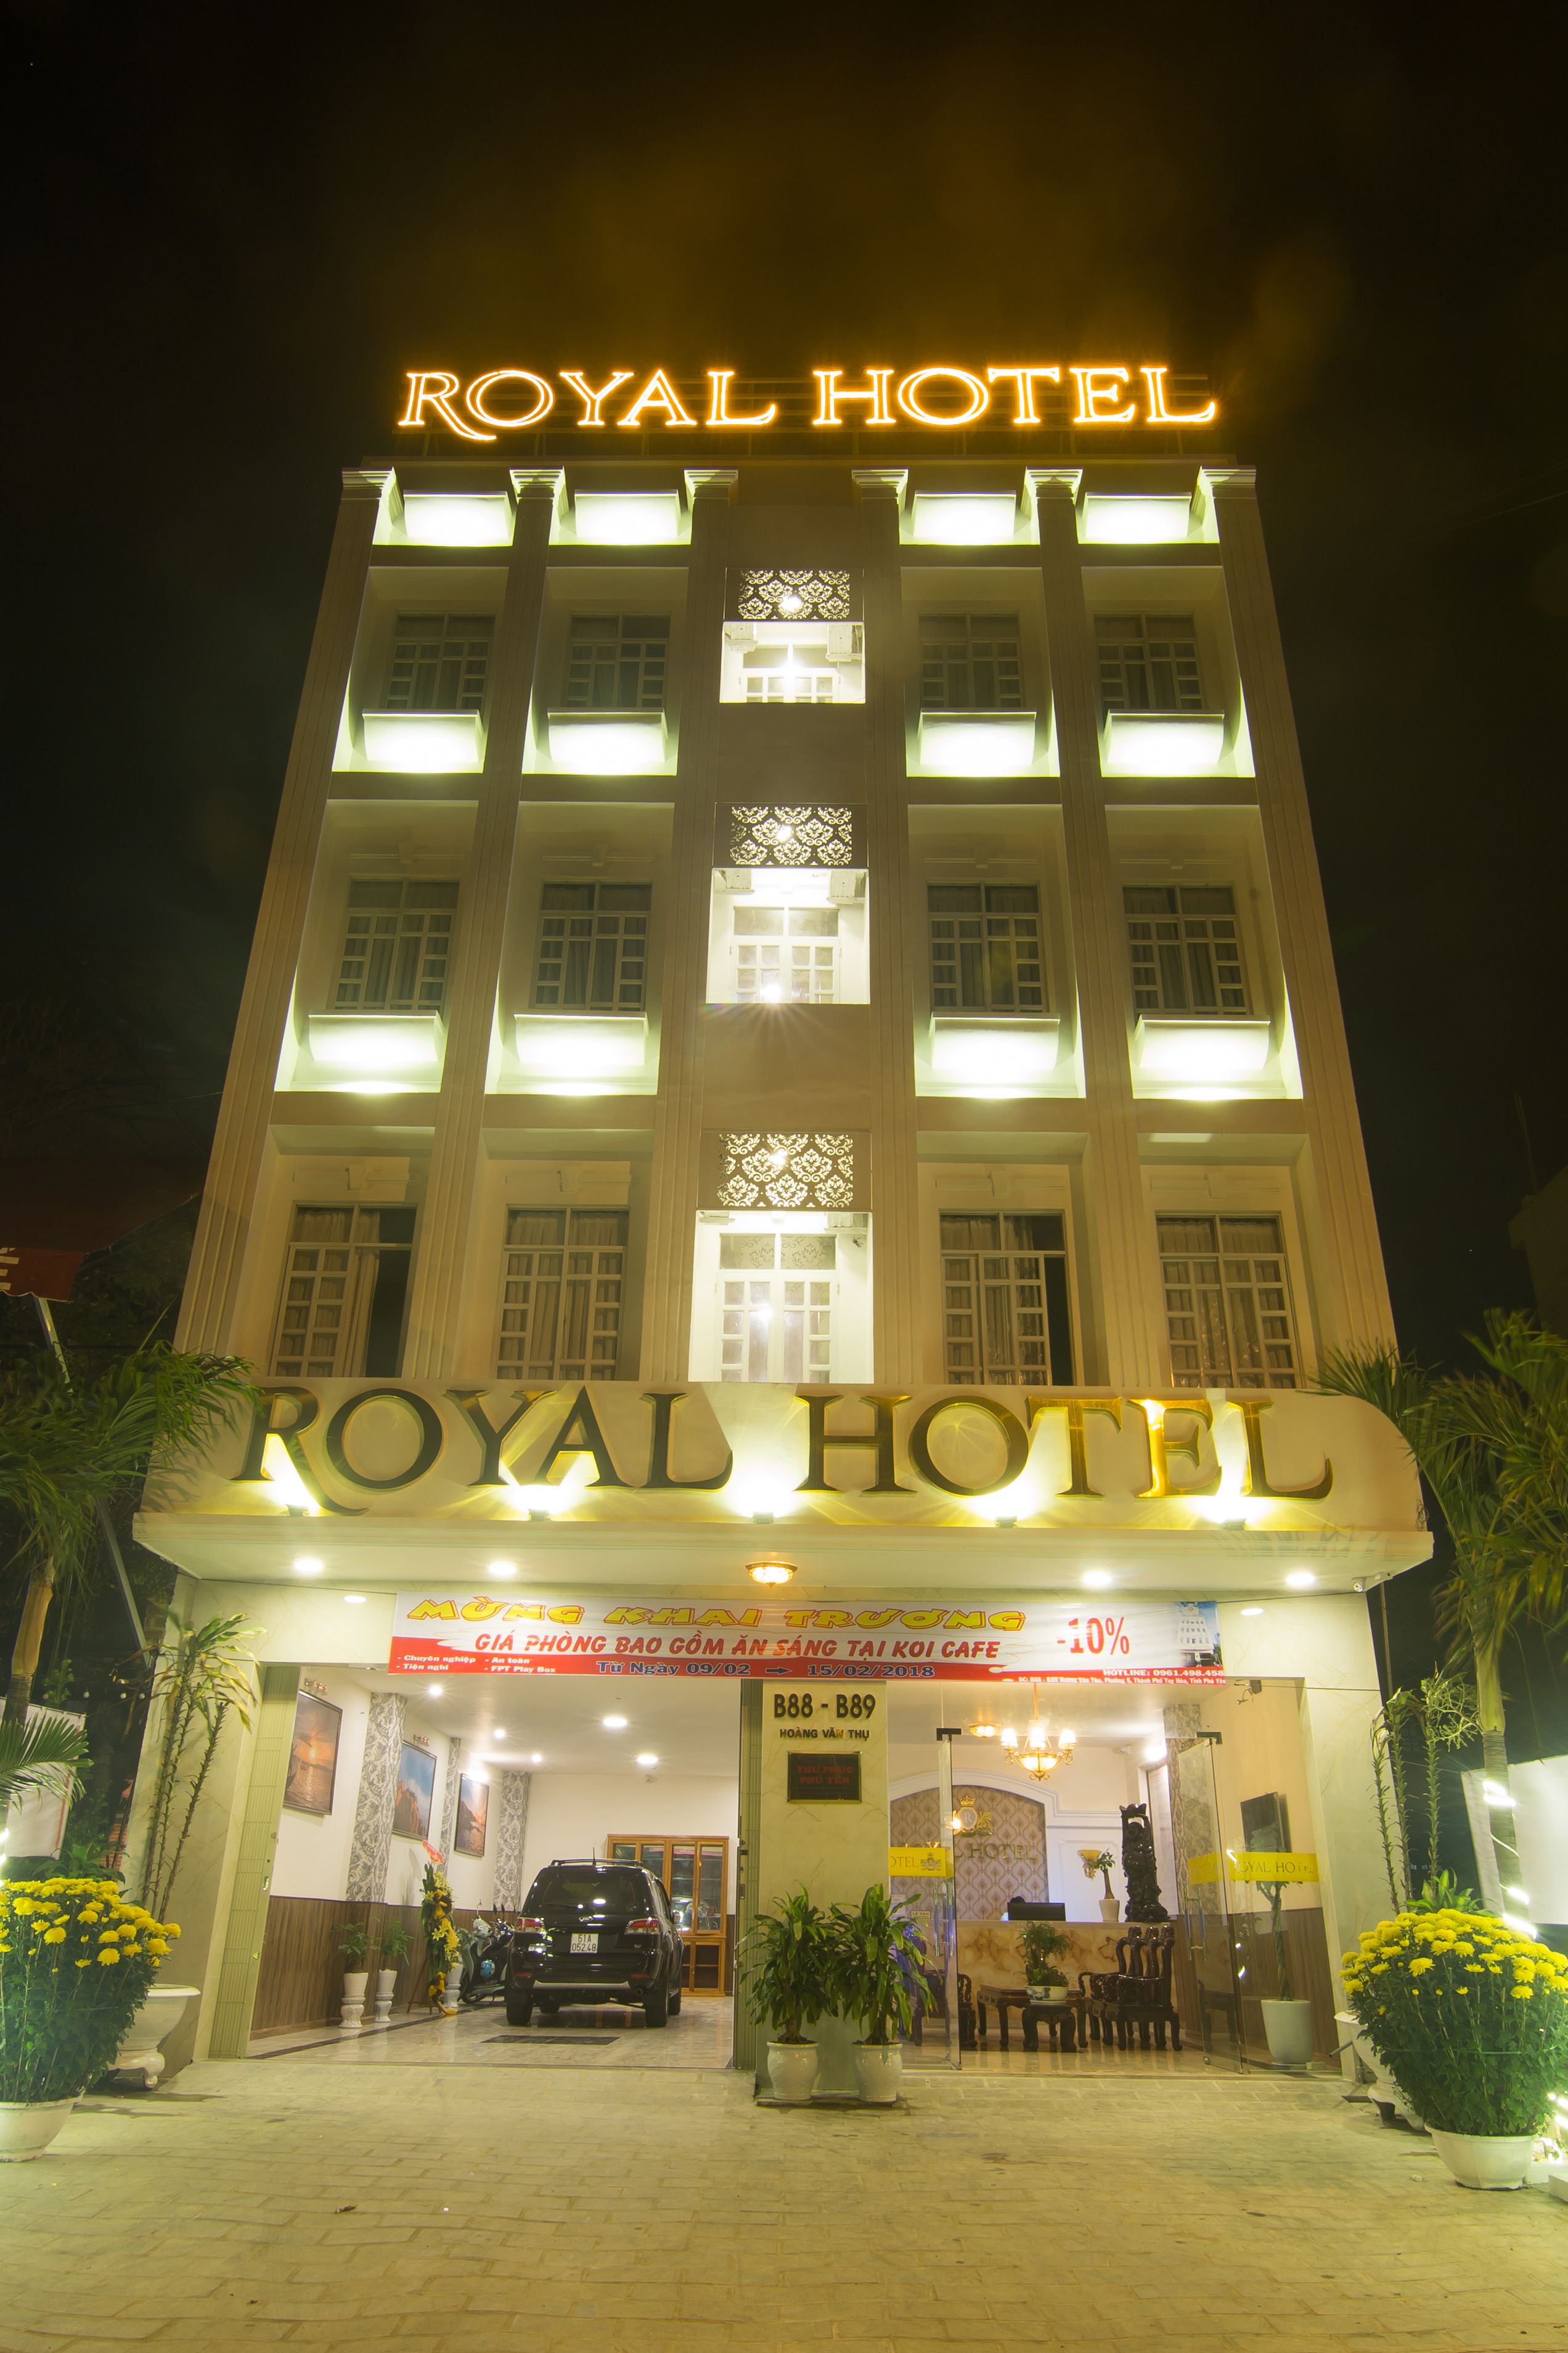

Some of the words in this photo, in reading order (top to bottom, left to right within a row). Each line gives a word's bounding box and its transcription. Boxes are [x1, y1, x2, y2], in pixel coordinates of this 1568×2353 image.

[398, 369, 776, 440] ROYAL
[812, 367, 1215, 425] HOTEL
[232, 1385, 733, 1514] ROYAL
[793, 1394, 1333, 1499] HOTEL
[407, 1596, 585, 1624] MỪNG
[603, 1607, 762, 1627] KHAI
[783, 1609, 1026, 1631] TRƯƠNG
[1056, 1617, 1130, 1655] -10%
[475, 1629, 515, 1651] GIÁ
[524, 1631, 607, 1653] PHÒNG
[615, 1636, 663, 1654] BAO
[669, 1630, 725, 1655] GỒM
[731, 1634, 769, 1656] ĂN
[773, 1635, 837, 1656] SÁNG
[847, 1640, 880, 1661] TẠI
[891, 1640, 935, 1658] KOI
[941, 1641, 1001, 1658] CAFE
[404, 1655, 439, 1663] Chuyên
[443, 1655, 476, 1663] nghiệp
[597, 1661, 625, 1673] Từ
[629, 1661, 680, 1676] Ngày
[685, 1663, 750, 1675] 09/02
[807, 1664, 934, 1677] 15/02/2018
[774, 1693, 814, 1718] B88
[836, 1693, 876, 1718] B89
[780, 1727, 819, 1738] HOÀNG
[822, 1727, 844, 1738] VĂN
[848, 1729, 870, 1741] THỤ
[966, 1843, 1037, 1859] HOTEL
[890, 1856, 919, 1868] OTEL
[1237, 1861, 1271, 1873] OYAL
[1276, 1862, 1314, 1873] HOT
[578, 1934, 592, 1943] 51A
[571, 1943, 597, 1952] 052.48
